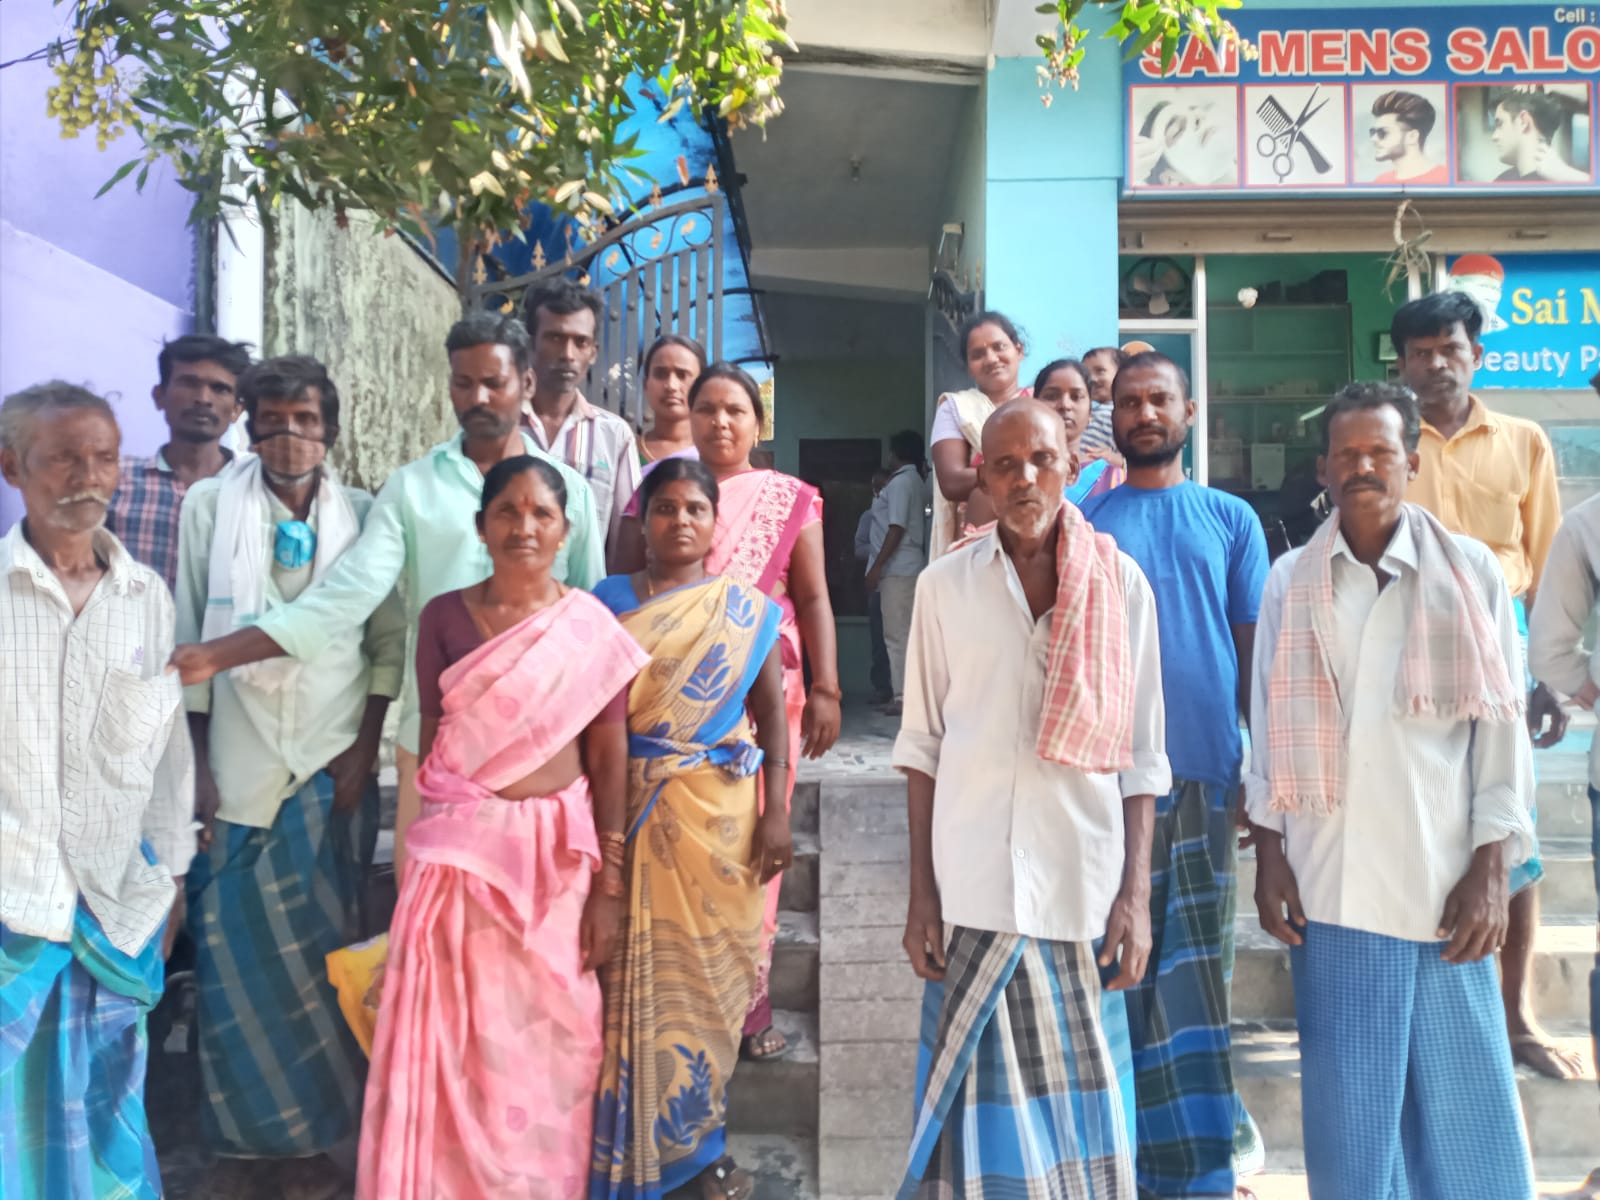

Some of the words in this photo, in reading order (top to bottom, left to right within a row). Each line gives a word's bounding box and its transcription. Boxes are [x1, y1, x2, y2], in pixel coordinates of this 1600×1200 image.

[1554, 7, 1585, 23] Cell
[1258, 28, 1431, 76] MENS
[1511, 287, 1569, 324] Sai
